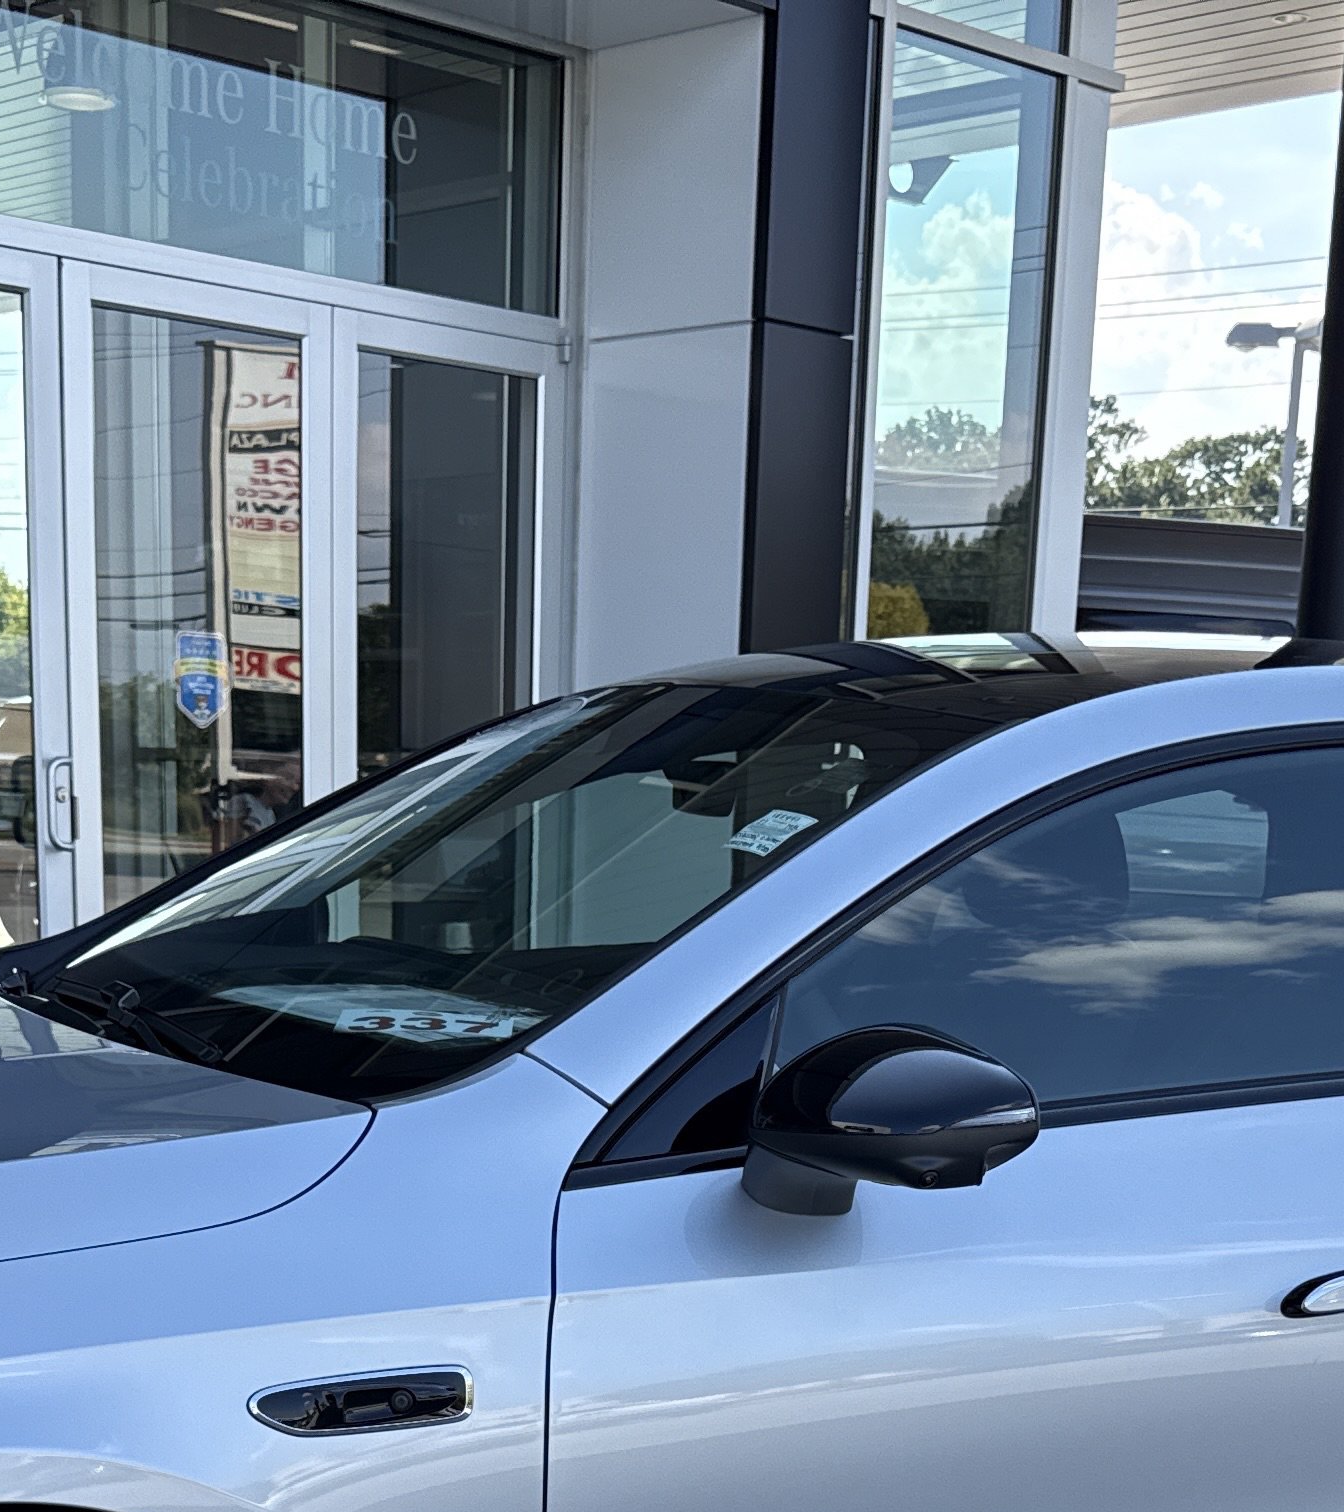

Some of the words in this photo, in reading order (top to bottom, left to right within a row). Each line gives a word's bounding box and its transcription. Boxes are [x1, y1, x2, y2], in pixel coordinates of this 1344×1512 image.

[263, 58, 419, 165] Home
[126, 123, 400, 246] Celebration
[347, 1015, 500, 1034] 337
